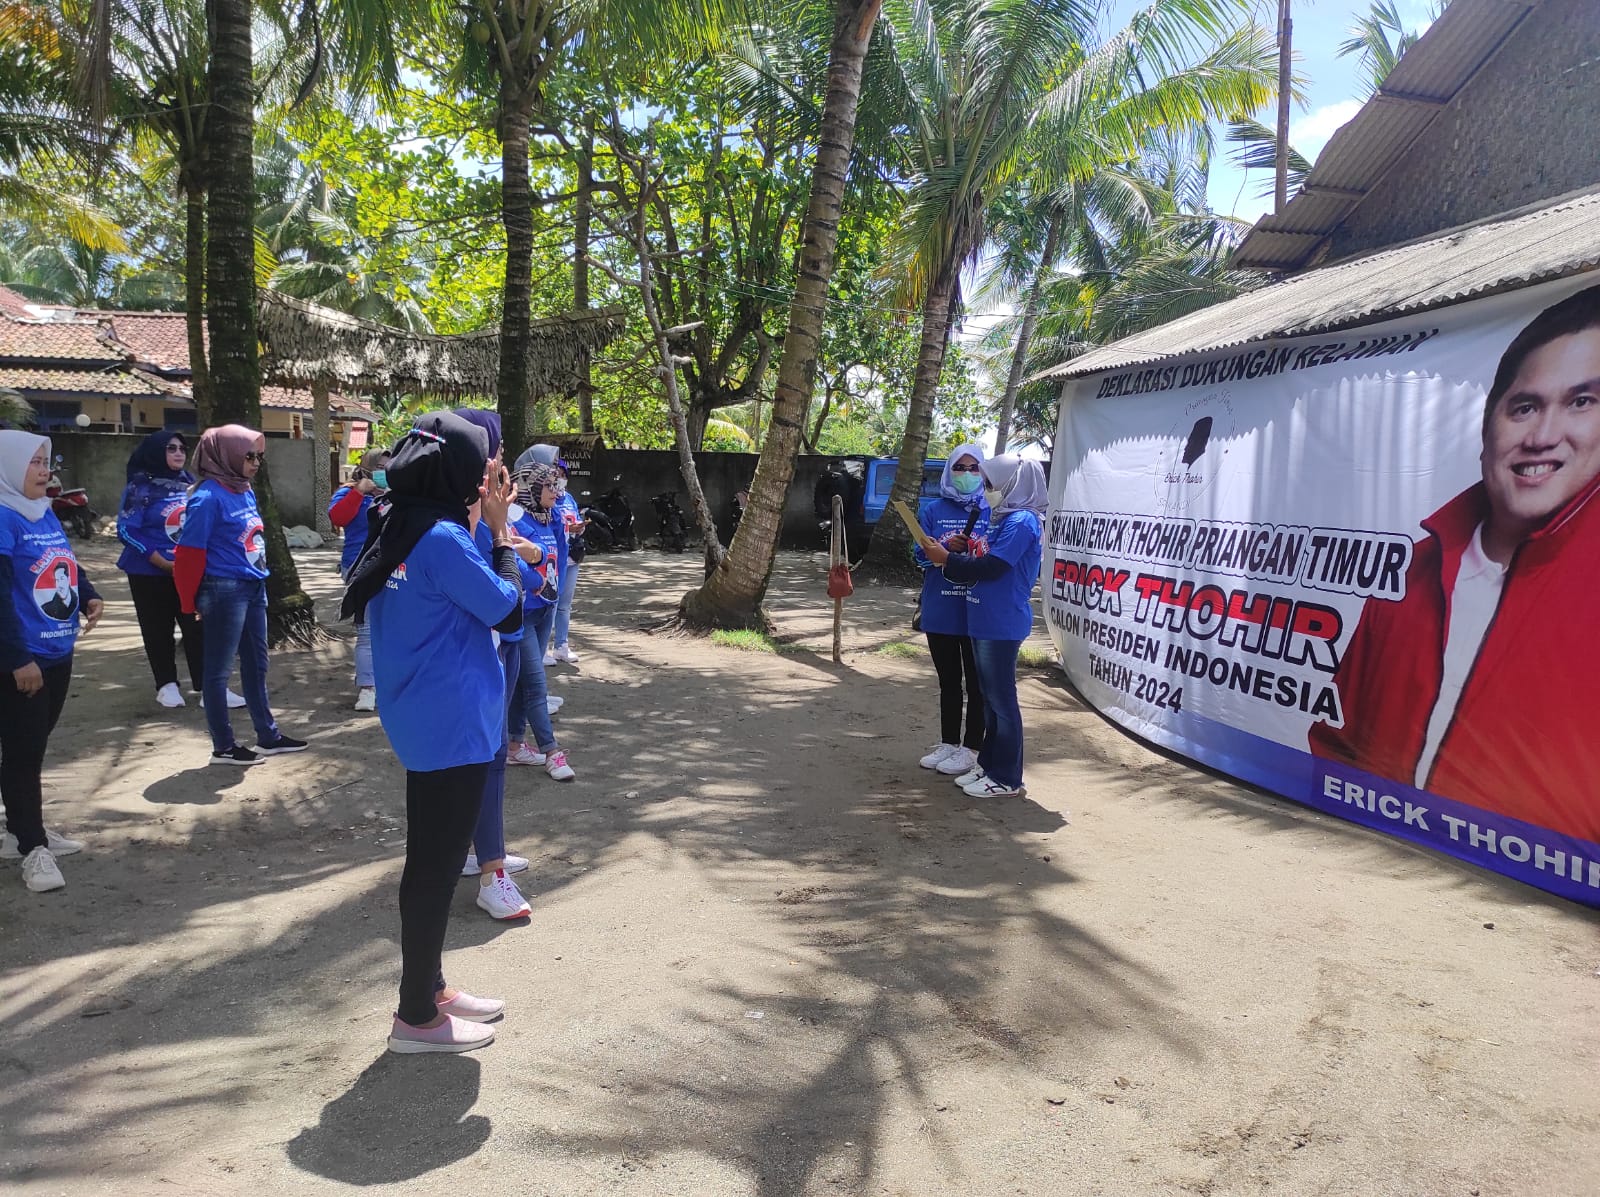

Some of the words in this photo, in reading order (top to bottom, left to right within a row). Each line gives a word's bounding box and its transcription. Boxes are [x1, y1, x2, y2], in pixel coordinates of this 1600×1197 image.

[1096, 366, 1178, 400] DEKLARASI
[1180, 348, 1294, 388] DUKUNGAN
[1292, 328, 1439, 371] RELAWAN
[1089, 518, 1127, 554] ERICK
[1127, 522, 1191, 562] THOHIR
[1191, 526, 1301, 577] PRIANGAN
[1306, 536, 1408, 592] TIMUR
[1052, 559, 1130, 617] ERICK
[1134, 573, 1343, 674] THOHIR
[1050, 607, 1080, 636] CALON
[1082, 617, 1162, 664] PRESIDEN
[1164, 644, 1341, 722] INDONESIA
[1089, 653, 1133, 693] TAHUN
[1135, 673, 1183, 713] 2024
[1323, 774, 1431, 831] ERICK
